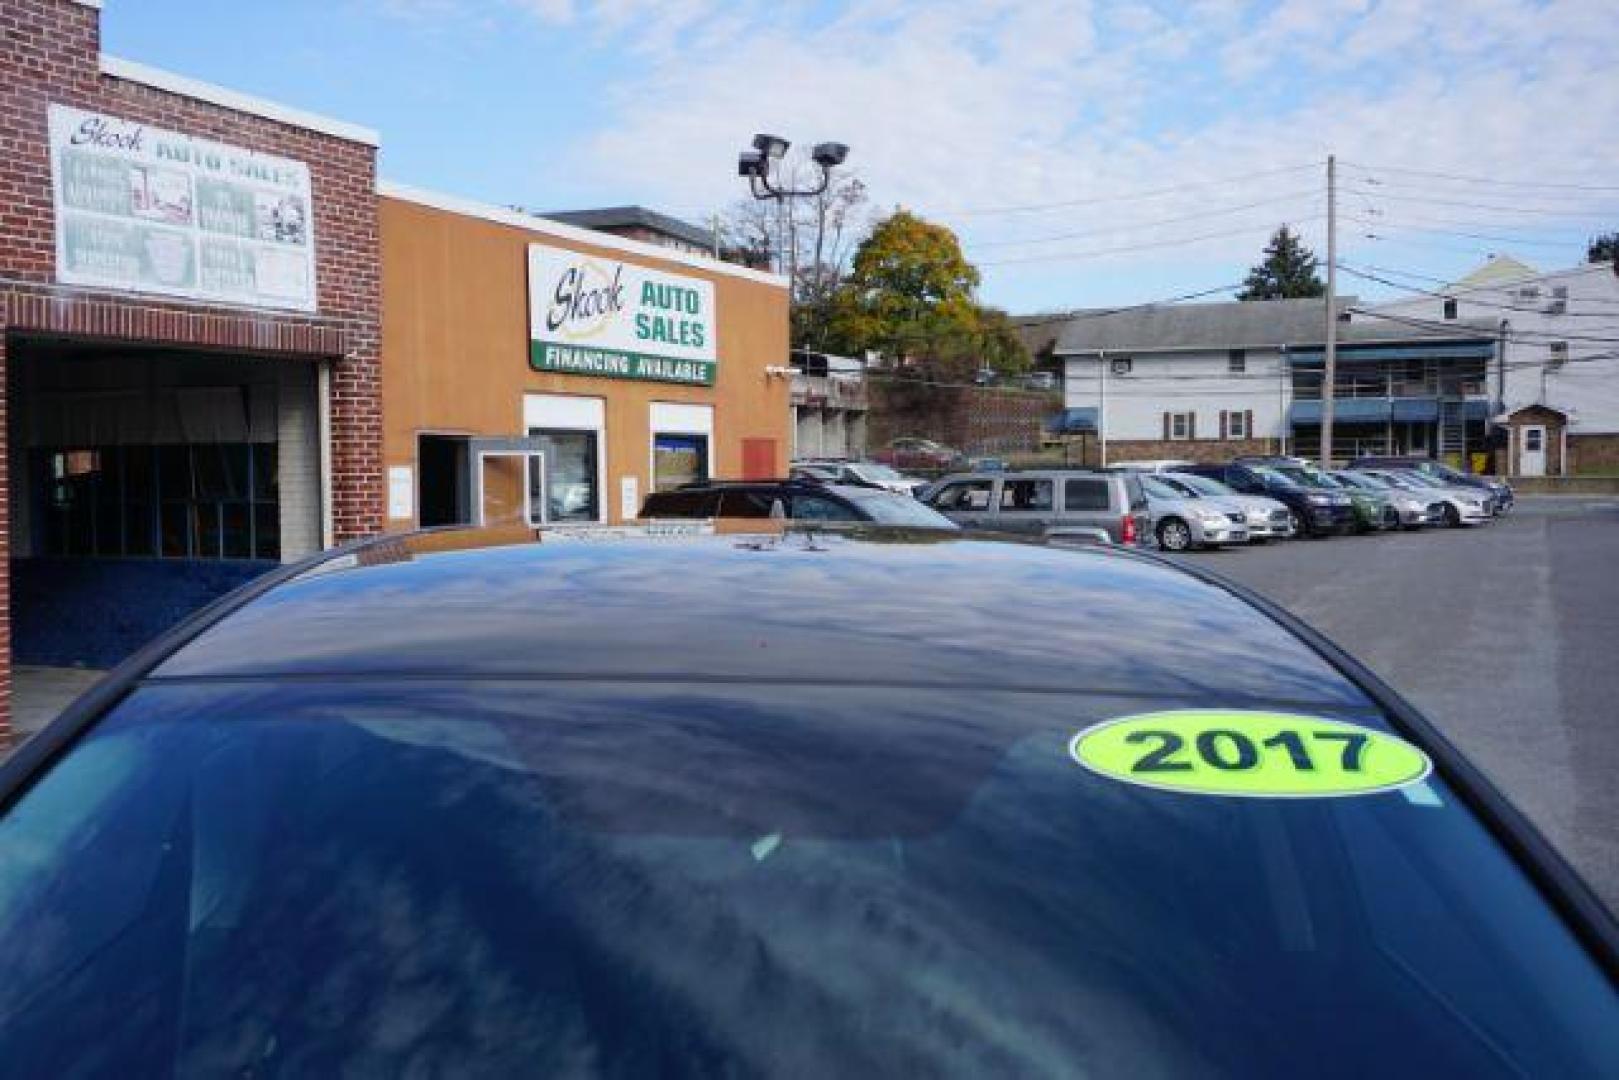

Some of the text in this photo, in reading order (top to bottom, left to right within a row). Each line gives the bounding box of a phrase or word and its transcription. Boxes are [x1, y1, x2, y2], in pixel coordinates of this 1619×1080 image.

[641, 280, 699, 315] AUTO
[635, 312, 704, 347] SALES
[545, 346, 707, 381] FINANCING AVAILABLE
[1124, 729, 1369, 773] 2017
